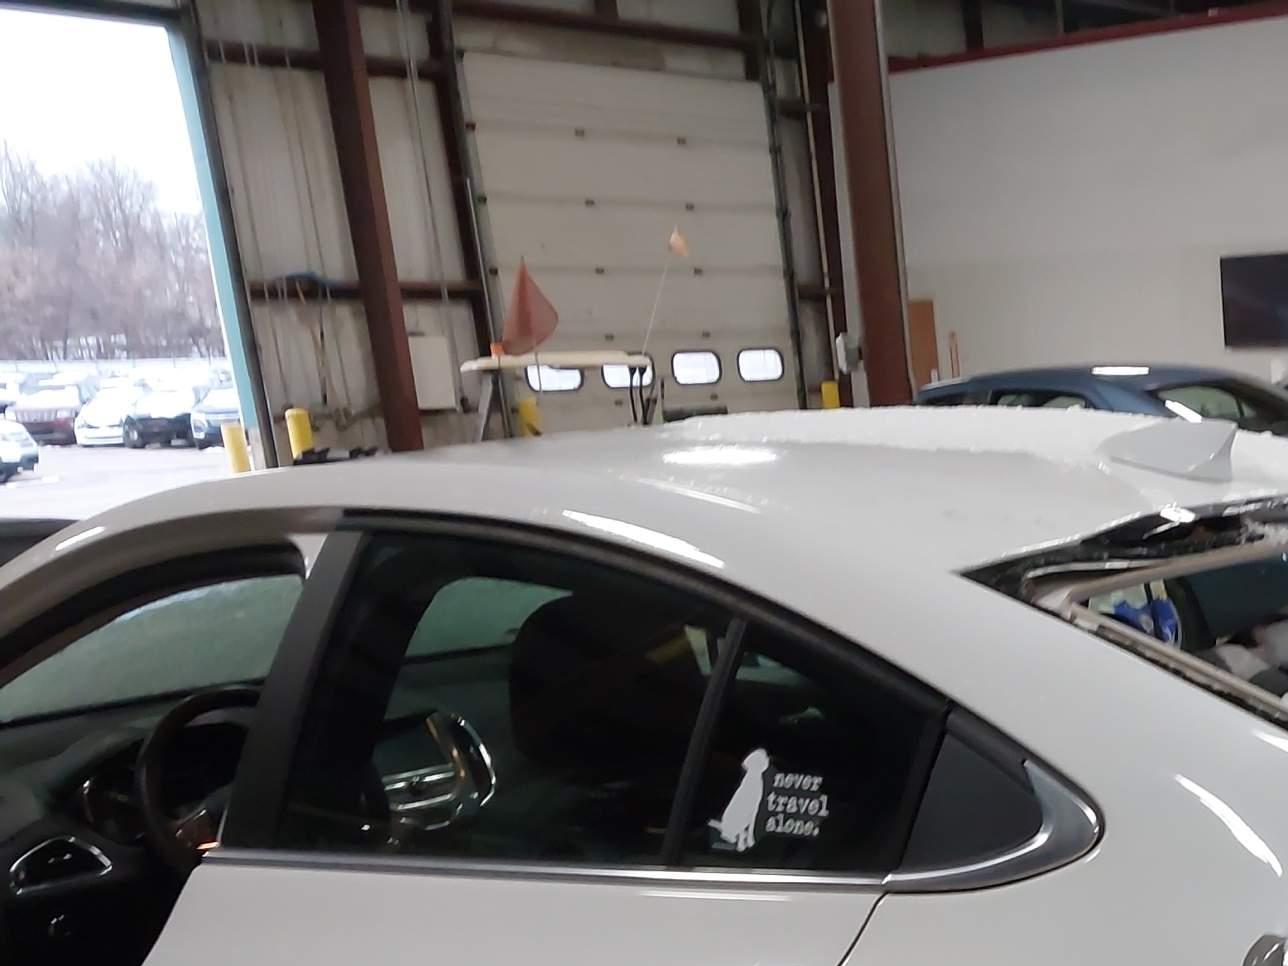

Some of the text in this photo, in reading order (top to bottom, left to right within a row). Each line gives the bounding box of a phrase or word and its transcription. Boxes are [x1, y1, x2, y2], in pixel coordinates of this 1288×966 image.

[772, 772, 824, 792] never
[766, 791, 830, 817] travel
[765, 813, 820, 837] alone.
